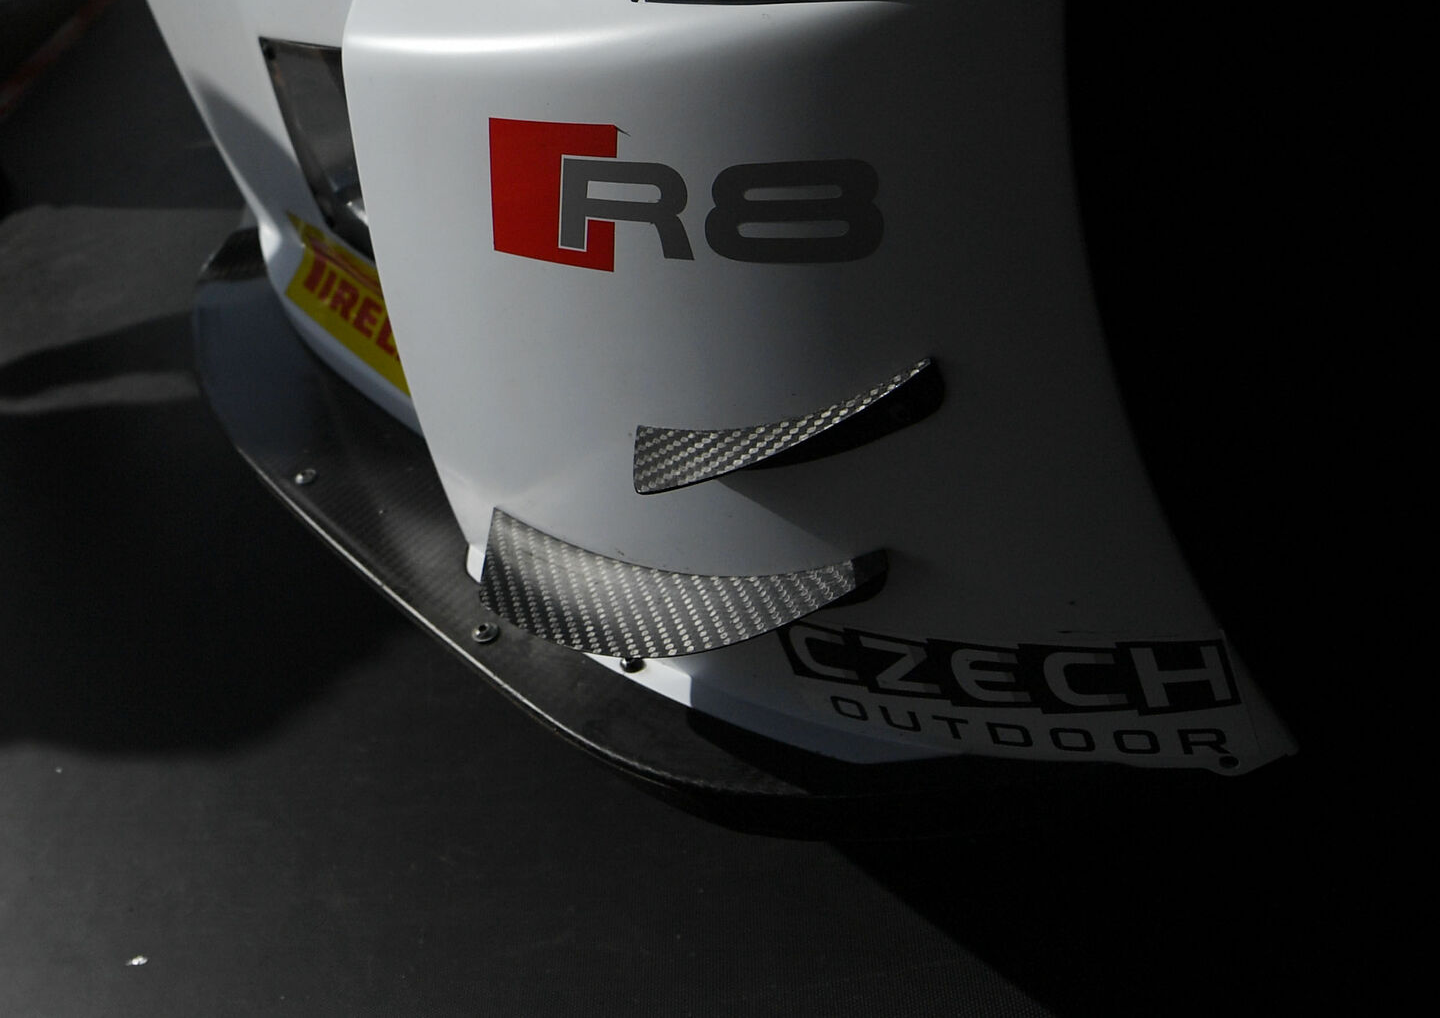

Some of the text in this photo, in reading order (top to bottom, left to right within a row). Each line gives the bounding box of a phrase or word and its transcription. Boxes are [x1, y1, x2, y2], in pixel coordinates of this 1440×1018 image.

[559, 157, 885, 264] R8
[786, 621, 1235, 710] CZECH
[830, 695, 1232, 756] OUTDOOR
